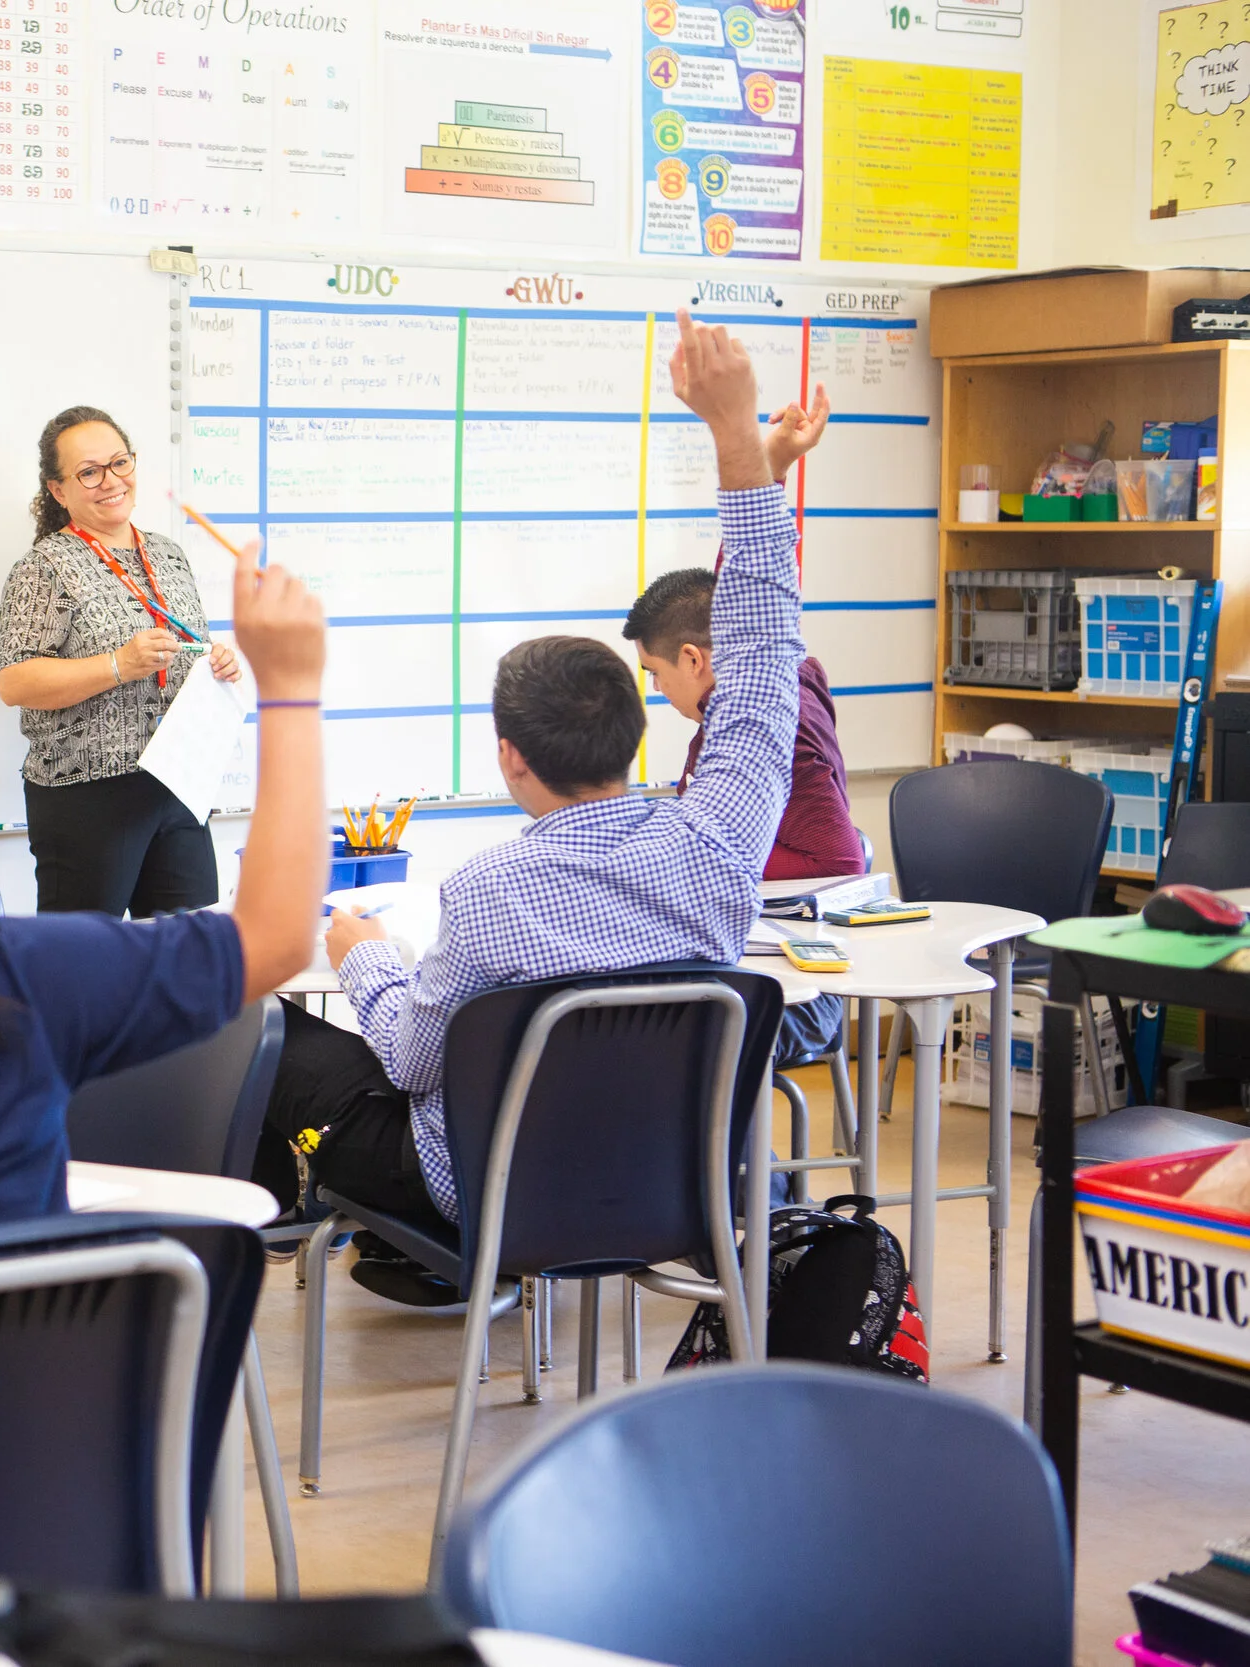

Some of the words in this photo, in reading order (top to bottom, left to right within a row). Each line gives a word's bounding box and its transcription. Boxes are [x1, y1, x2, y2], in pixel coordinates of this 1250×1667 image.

[194, 5, 215, 30] of
[222, 0, 347, 34] Operations
[653, 8, 671, 28] 2
[890, 5, 910, 30] 10
[384, 30, 423, 44] Resolver
[426, 34, 438, 44] de
[440, 35, 480, 50] izquierda
[489, 40, 524, 54] derecha
[421, 18, 461, 34] Plantar
[464, 23, 477, 35] Es
[536, 31, 553, 43] Sin
[557, 33, 590, 48] Regar
[732, 21, 750, 42] 3
[113, 48, 123, 60] P
[157, 52, 166, 65] E
[198, 56, 209, 68] M
[242, 60, 252, 72] D
[284, 63, 295, 75] A
[326, 66, 336, 79] S
[652, 61, 672, 83] 4
[1198, 58, 1240, 78] THINK
[113, 83, 147, 95] Please
[157, 87, 192, 98] Excuse
[198, 90, 213, 102] My
[242, 93, 266, 105] Dear
[285, 96, 307, 108] Aunt
[327, 100, 349, 112] Sally
[753, 88, 770, 108] 5
[1200, 80, 1236, 97] TIME
[22, 103, 42, 116] 59
[475, 132, 519, 148] Potencias
[659, 124, 679, 146] 6
[472, 180, 503, 193] Sumas
[514, 183, 543, 196] restas
[662, 172, 682, 193] 8
[706, 170, 723, 191] 9
[26, 186, 40, 197] 99
[53, 187, 72, 199] 100
[710, 229, 729, 249] 10
[333, 264, 395, 296] UDC
[513, 273, 574, 304] GWU
[697, 281, 776, 304] VIRGINIA
[826, 293, 857, 308] GED
[862, 294, 899, 310] PREP
[191, 313, 235, 340] Monday
[191, 354, 234, 377] Lunes
[192, 420, 241, 446] Tuesday
[193, 468, 245, 487] Martes
